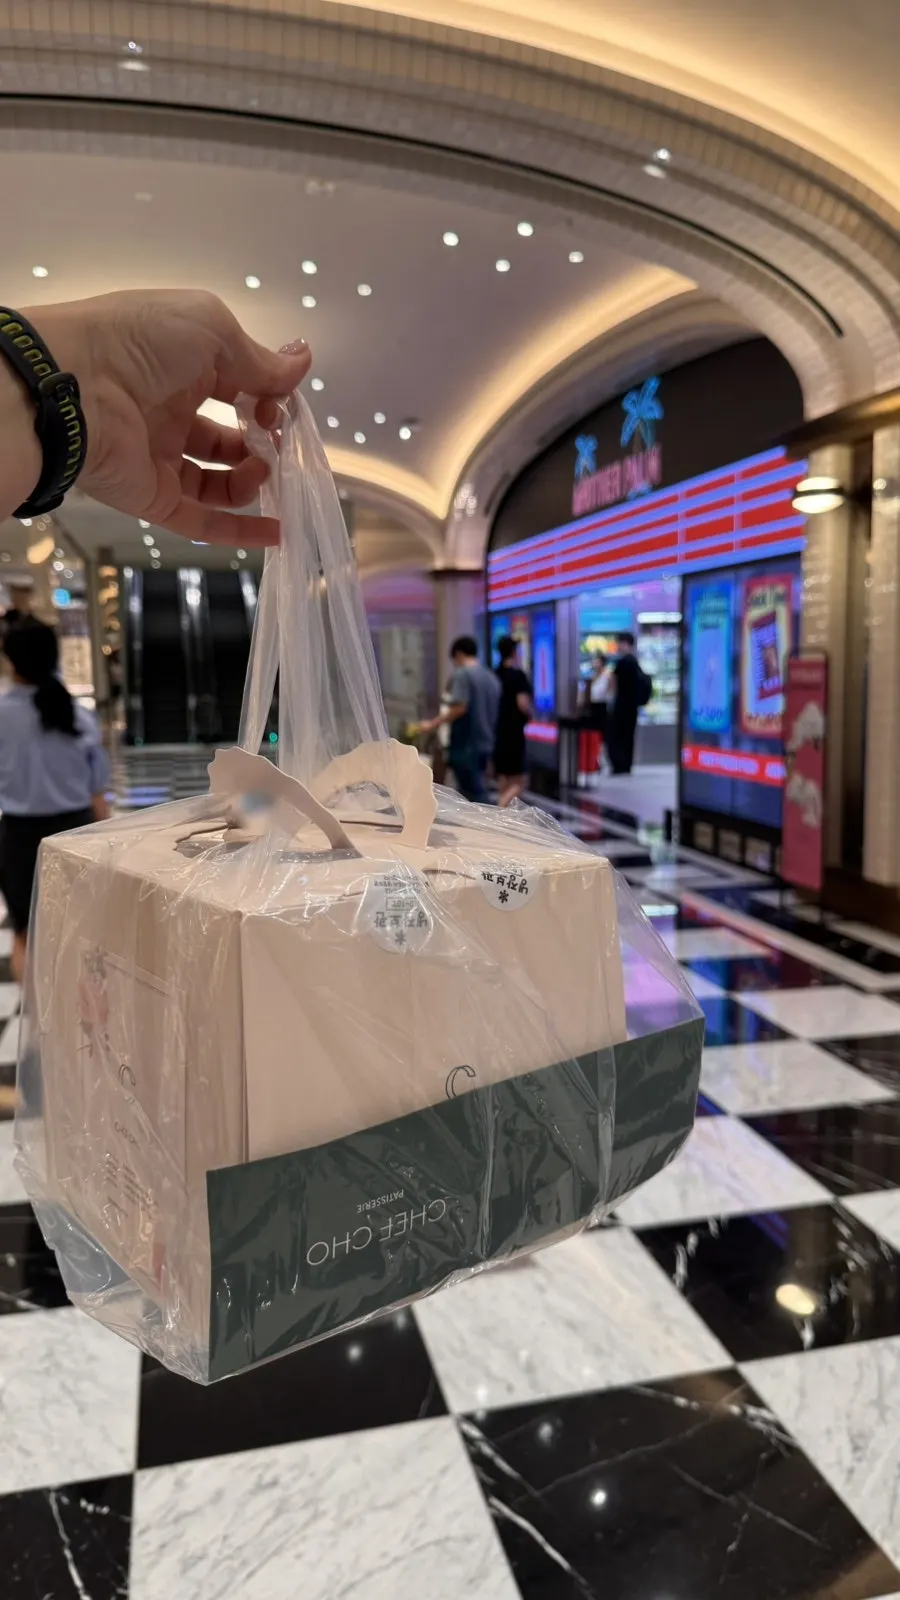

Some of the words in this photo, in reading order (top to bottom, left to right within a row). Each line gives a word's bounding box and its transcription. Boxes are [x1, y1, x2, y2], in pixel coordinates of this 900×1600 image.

[373, 911, 428, 928] 냉장보관
[356, 1189, 405, 1214] PATISSERIE
[379, 1199, 446, 1242] CHEF
[306, 1226, 372, 1266] CHO
